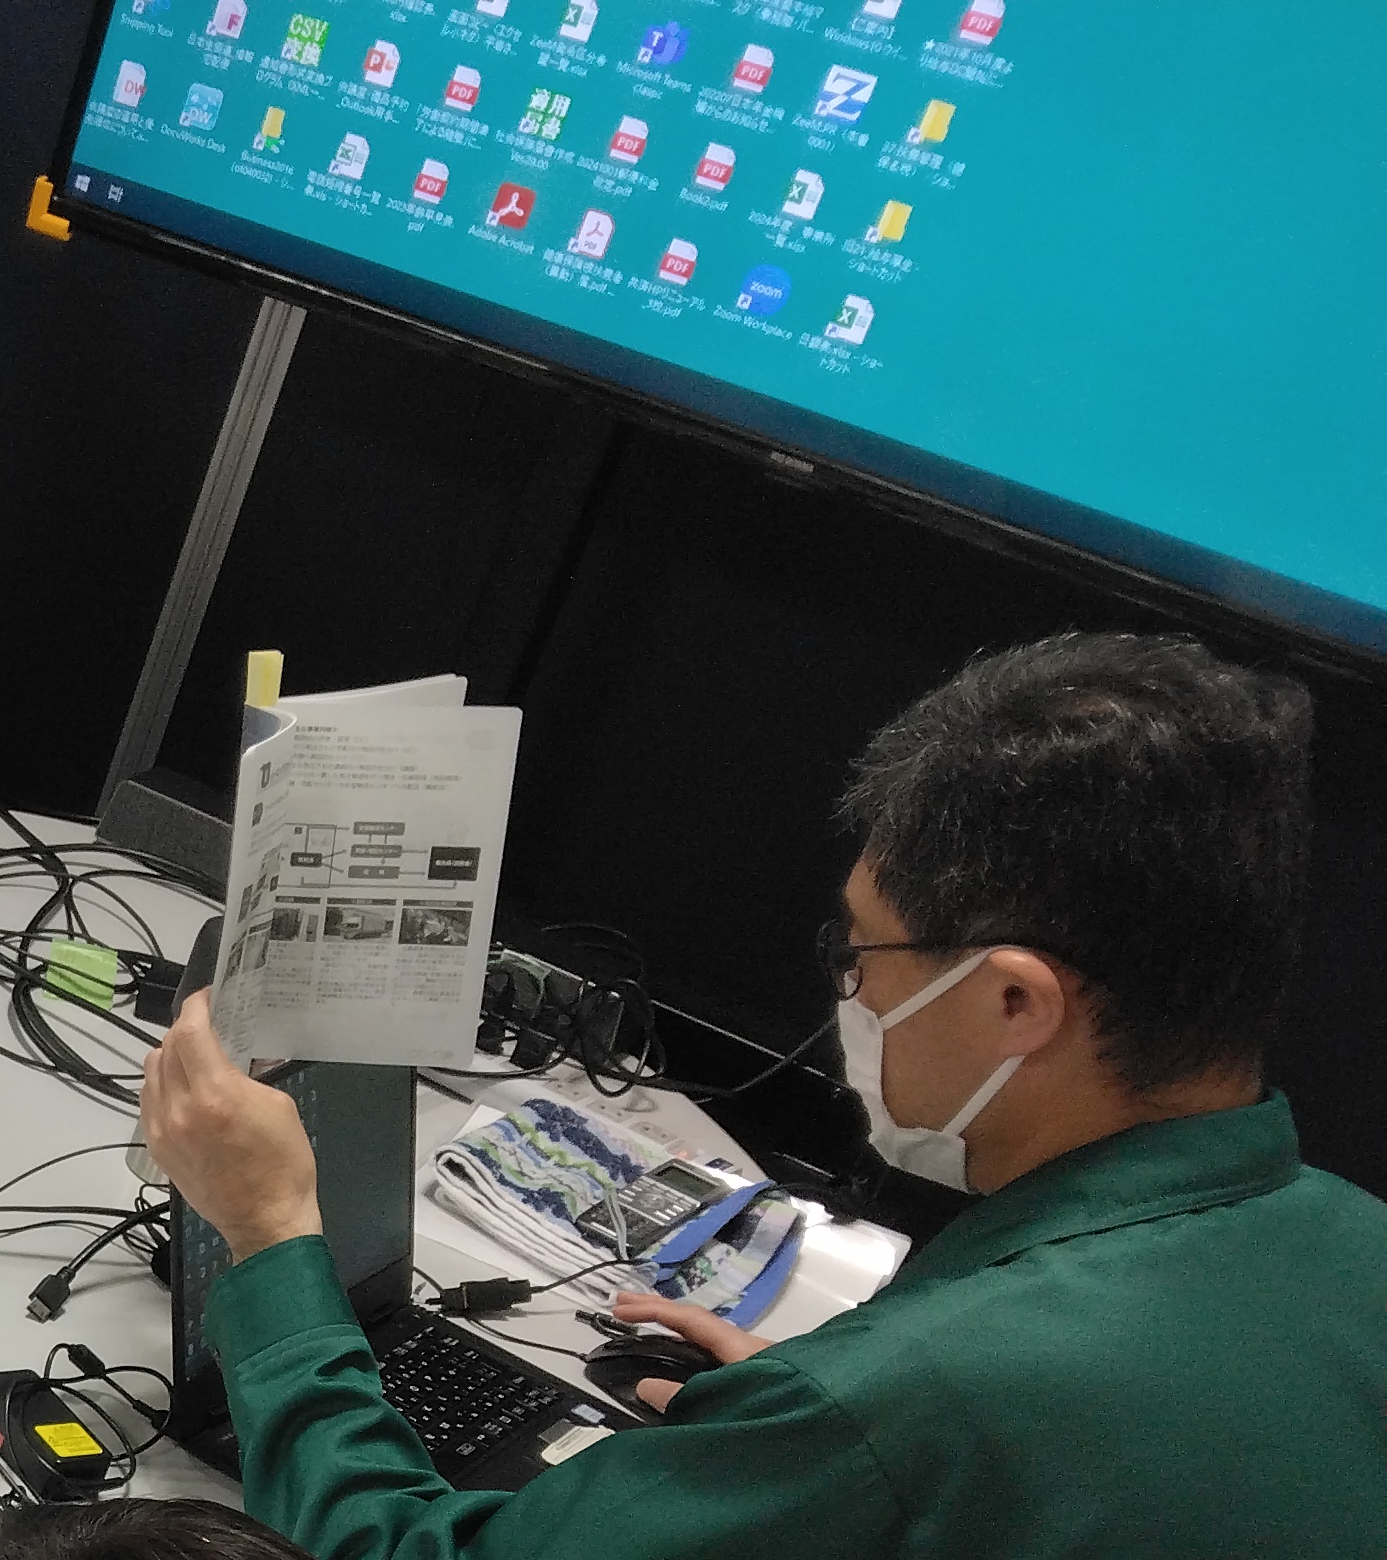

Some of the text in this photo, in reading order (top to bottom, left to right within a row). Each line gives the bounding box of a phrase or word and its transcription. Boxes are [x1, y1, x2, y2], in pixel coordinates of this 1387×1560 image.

[289, 13, 328, 44] CSV
[969, 16, 993, 32] PDF
[740, 65, 765, 81] PDF
[451, 84, 475, 101] PDF
[616, 135, 640, 152] PDF
[702, 163, 727, 179] PDF
[419, 178, 442, 195] PDF
[666, 258, 689, 274] PDF
[751, 280, 783, 300] zoom
